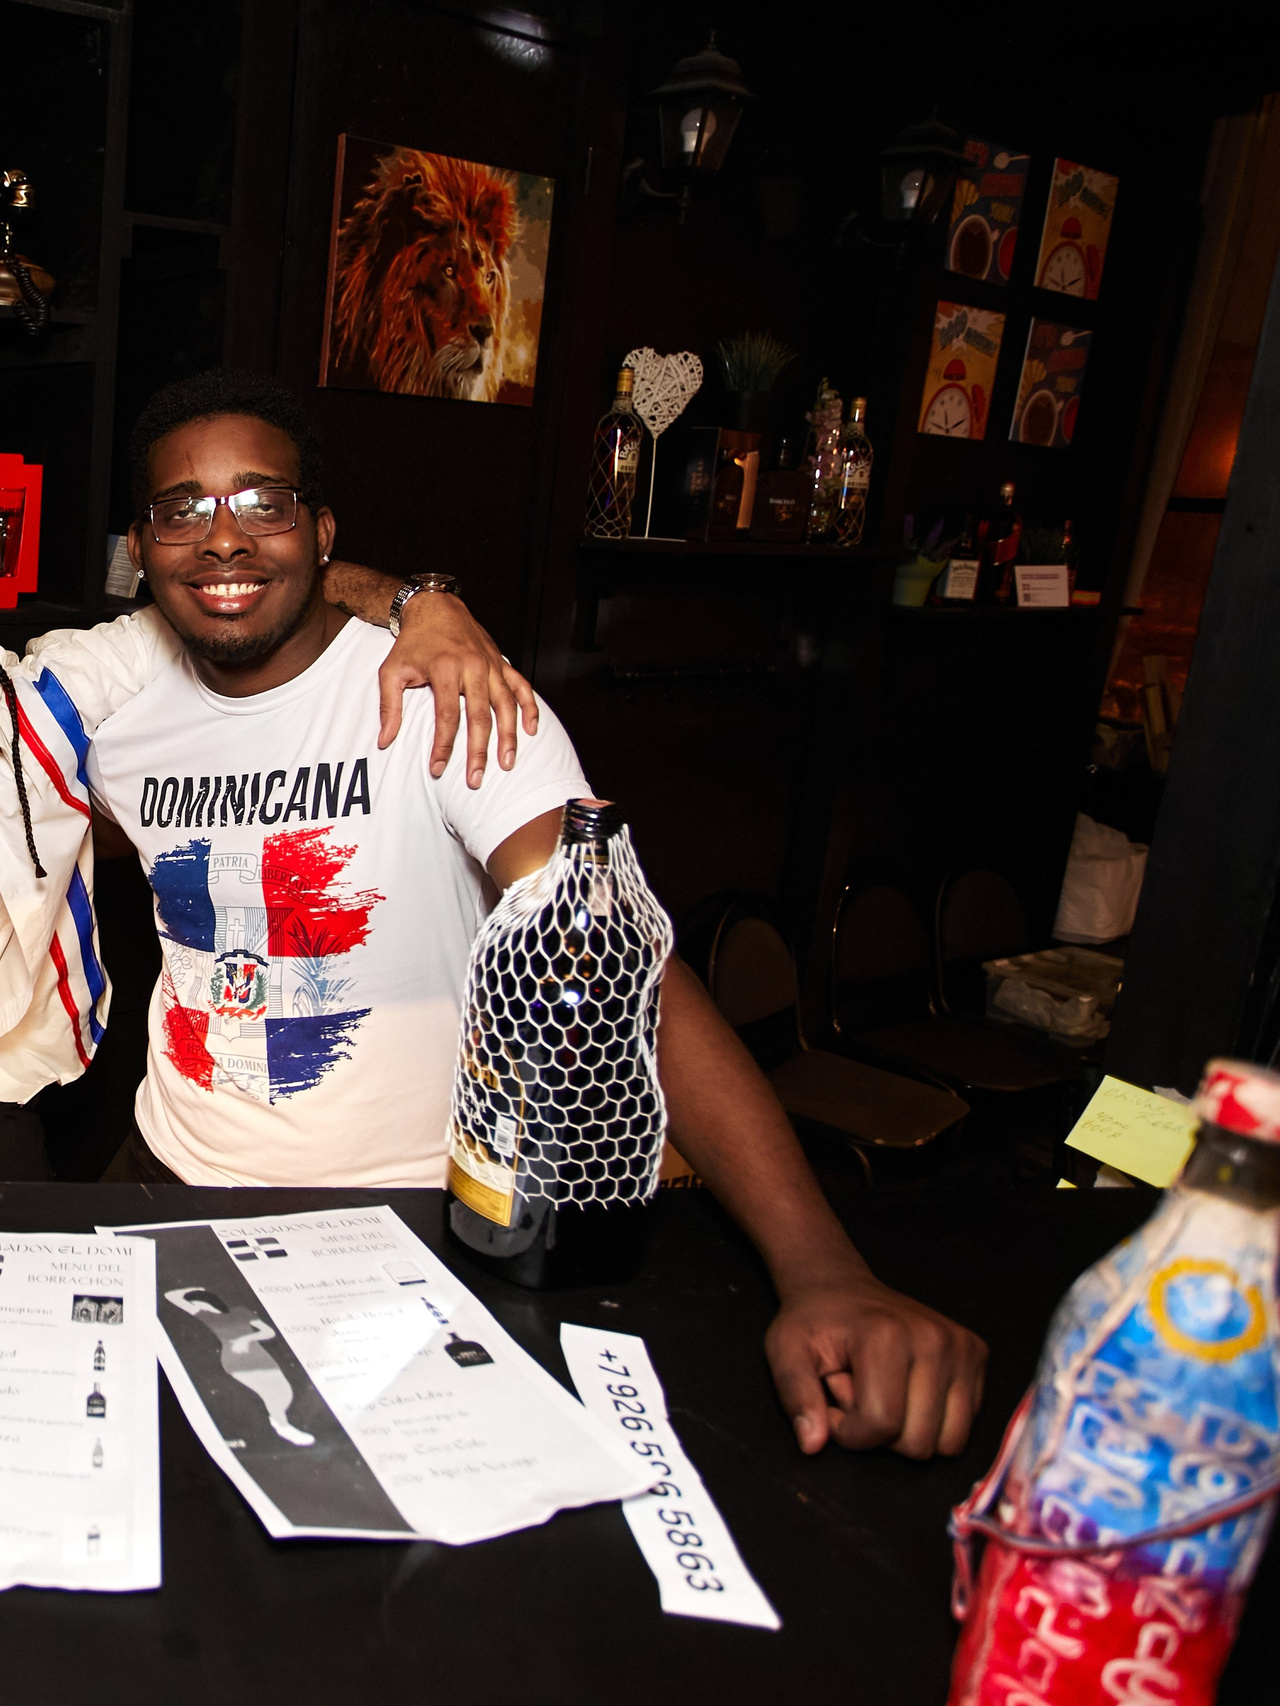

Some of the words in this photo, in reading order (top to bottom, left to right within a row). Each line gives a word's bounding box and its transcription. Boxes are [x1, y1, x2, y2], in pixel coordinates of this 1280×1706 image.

[140, 757, 371, 828] DOMINICANA
[213, 856, 249, 869] PATRIA
[258, 869, 310, 892] LIBERTAD
[316, 1219, 340, 1229] EL
[340, 1216, 382, 1227] DOMI
[320, 1233, 359, 1243] MENU
[361, 1231, 385, 1240] DEL
[58, 1245, 81, 1255] EL
[87, 1246, 132, 1256] DOMI
[51, 1262, 92, 1272] MENU
[98, 1263, 125, 1273] DEL
[28, 1275, 123, 1287] BORRACHON
[598, 1347, 631, 1381] +7
[611, 1383, 654, 1432] 926
[658, 1509, 724, 1593] 5863
